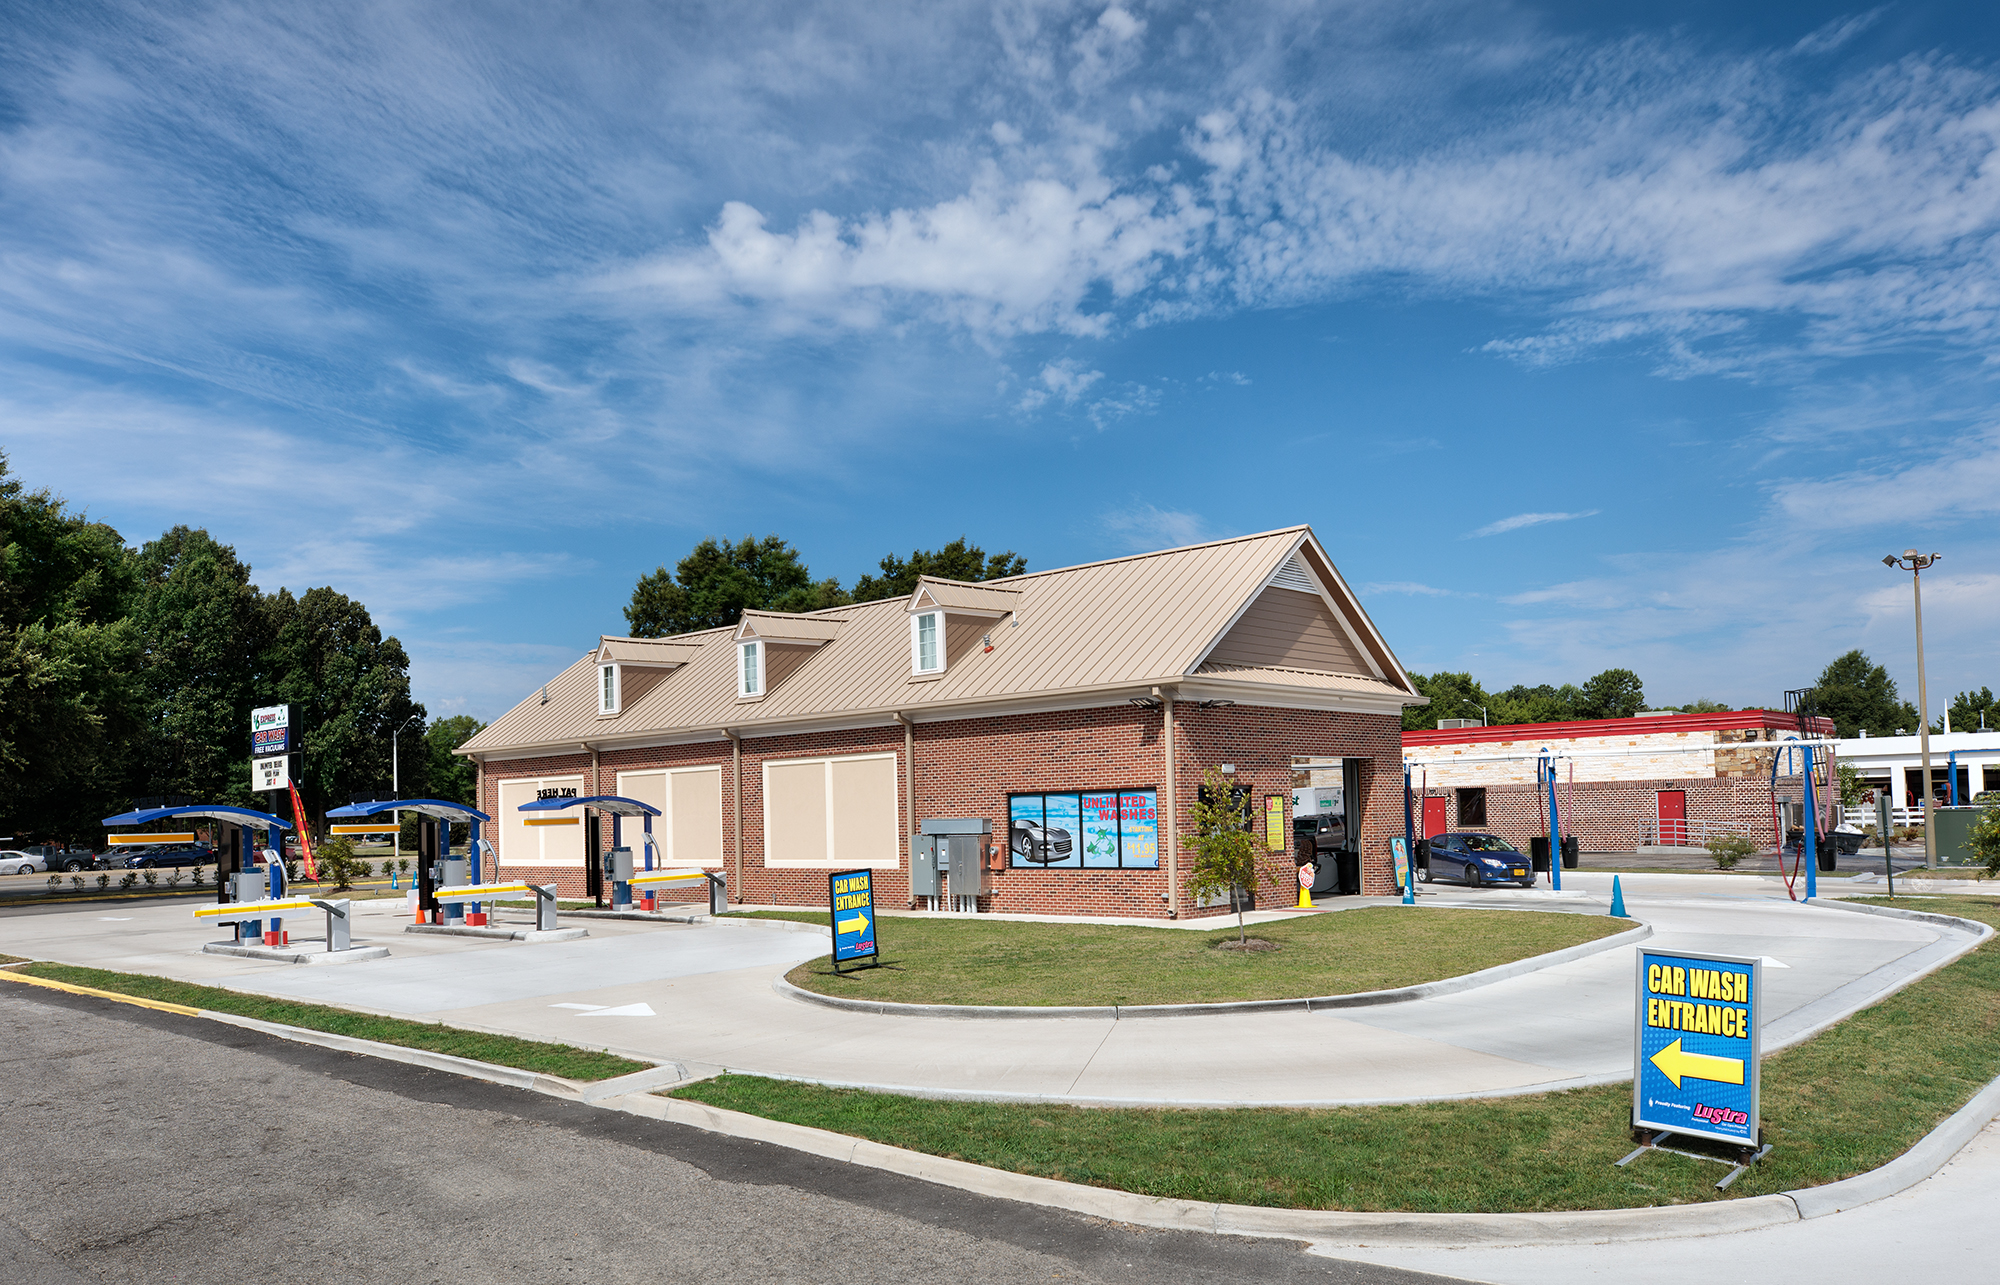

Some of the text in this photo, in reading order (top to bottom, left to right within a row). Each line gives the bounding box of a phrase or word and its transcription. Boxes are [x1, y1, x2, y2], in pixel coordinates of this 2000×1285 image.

[255, 728, 285, 743] CAR WASH
[1083, 796, 1146, 808] UNLIMITED
[1098, 808, 1156, 821] WASHES
[1127, 842, 1156, 854] $11.95
[835, 875, 869, 895] CAR WASH
[835, 892, 870, 911] ENTRANCE
[1648, 963, 1748, 1003] CAR WASH
[1647, 997, 1748, 1038] ENTRANCE
[1671, 1103, 1691, 1111] Featuring
[1693, 1103, 1748, 1125] Lustra
